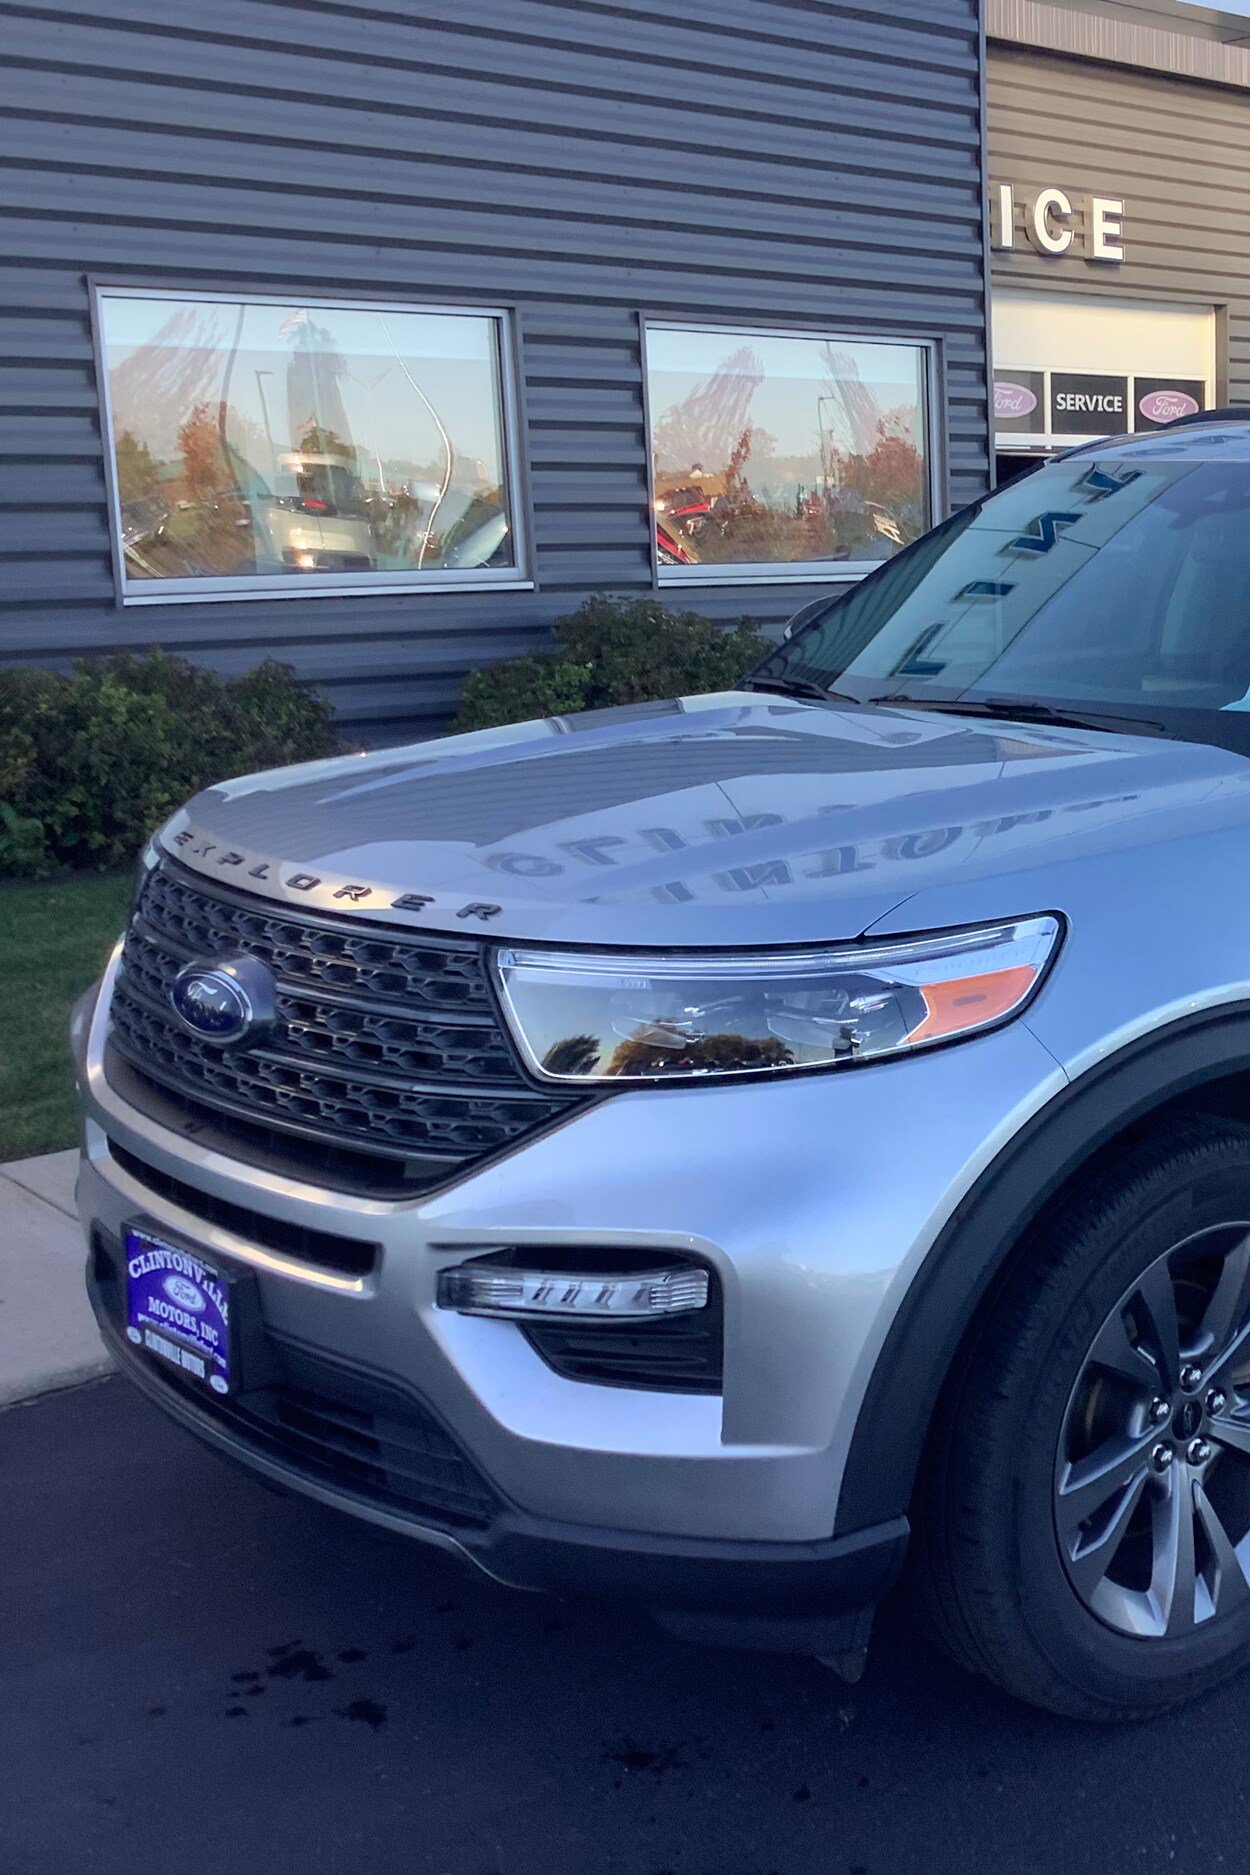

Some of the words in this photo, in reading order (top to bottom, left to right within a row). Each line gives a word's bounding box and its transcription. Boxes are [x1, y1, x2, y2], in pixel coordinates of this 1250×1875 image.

[1056, 393, 1123, 412] SERVICE
[1152, 395, 1187, 417] Ford
[173, 831, 502, 921] EXPLORER
